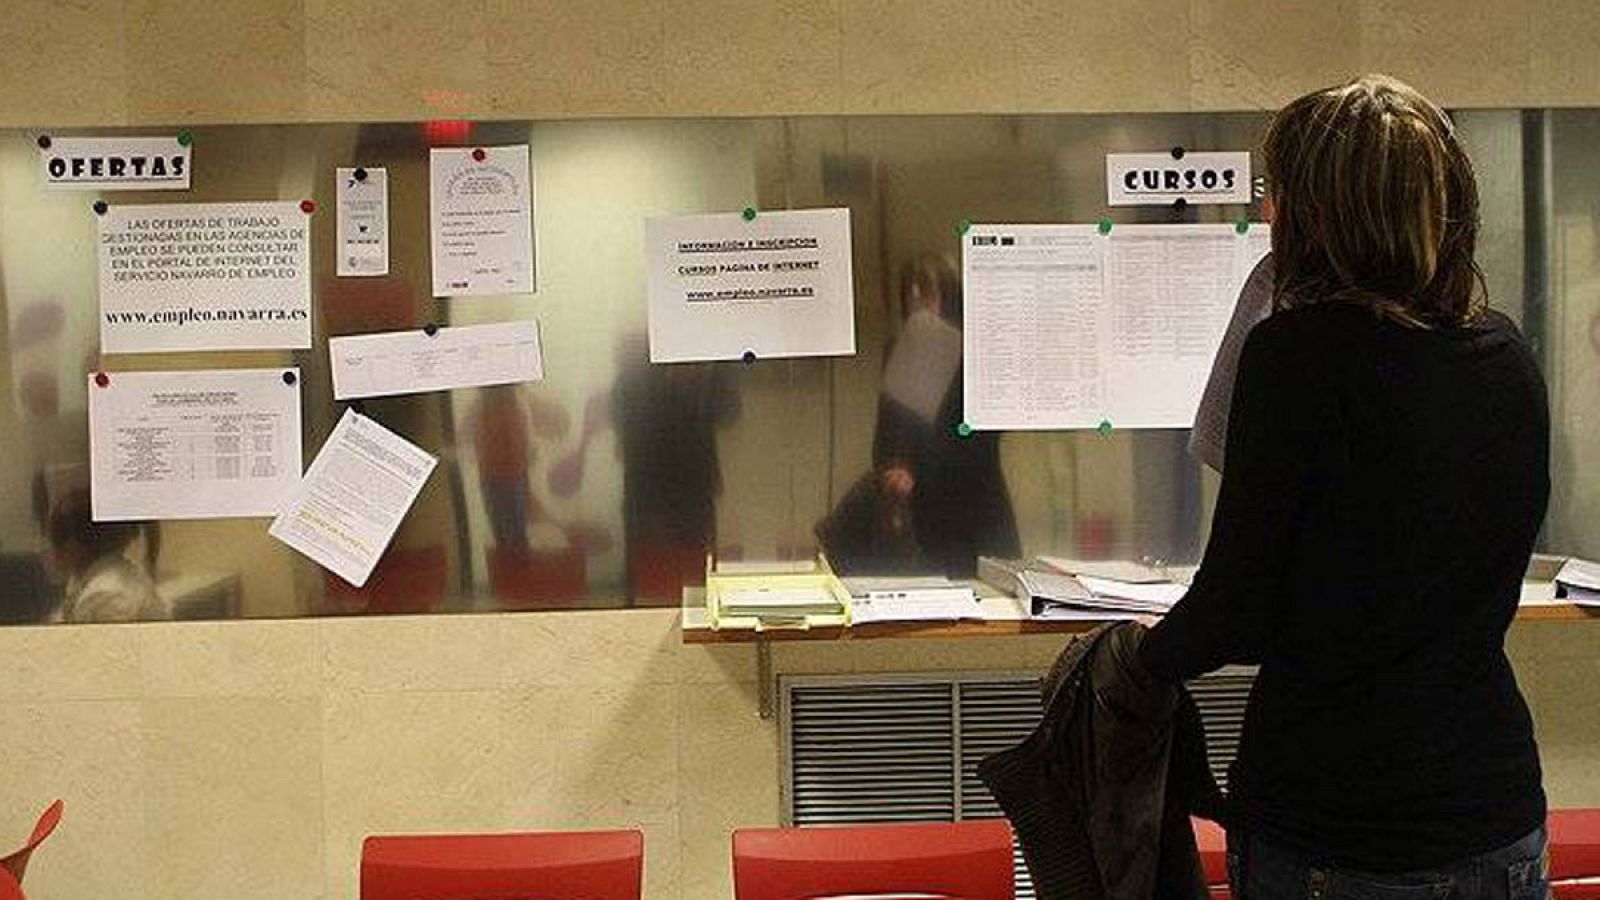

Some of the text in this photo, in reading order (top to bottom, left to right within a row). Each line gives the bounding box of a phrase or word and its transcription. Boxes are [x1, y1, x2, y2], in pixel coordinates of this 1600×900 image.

[48, 156, 186, 178] OFERTAS
[1123, 169, 1236, 190] CURSOS
[127, 217, 280, 230] LAS OFERTAS DE TRABAJO
[186, 232, 202, 241] EN
[203, 231, 226, 241] LAS
[228, 231, 288, 241] AGENCIAS
[290, 230, 303, 240] DE
[110, 243, 298, 257] EMPLEO SE PUEDEN CONSULTAR
[112, 256, 297, 269] EN EL PORTAL DE INTERNET DEL
[678, 265, 717, 276] CURSOS
[758, 262, 770, 272] DE
[772, 260, 820, 271] INTERNET
[113, 268, 297, 282] SERVICIO NAVARRO DE EMPLEO
[106, 306, 308, 326] www.empleo.navarra.es
